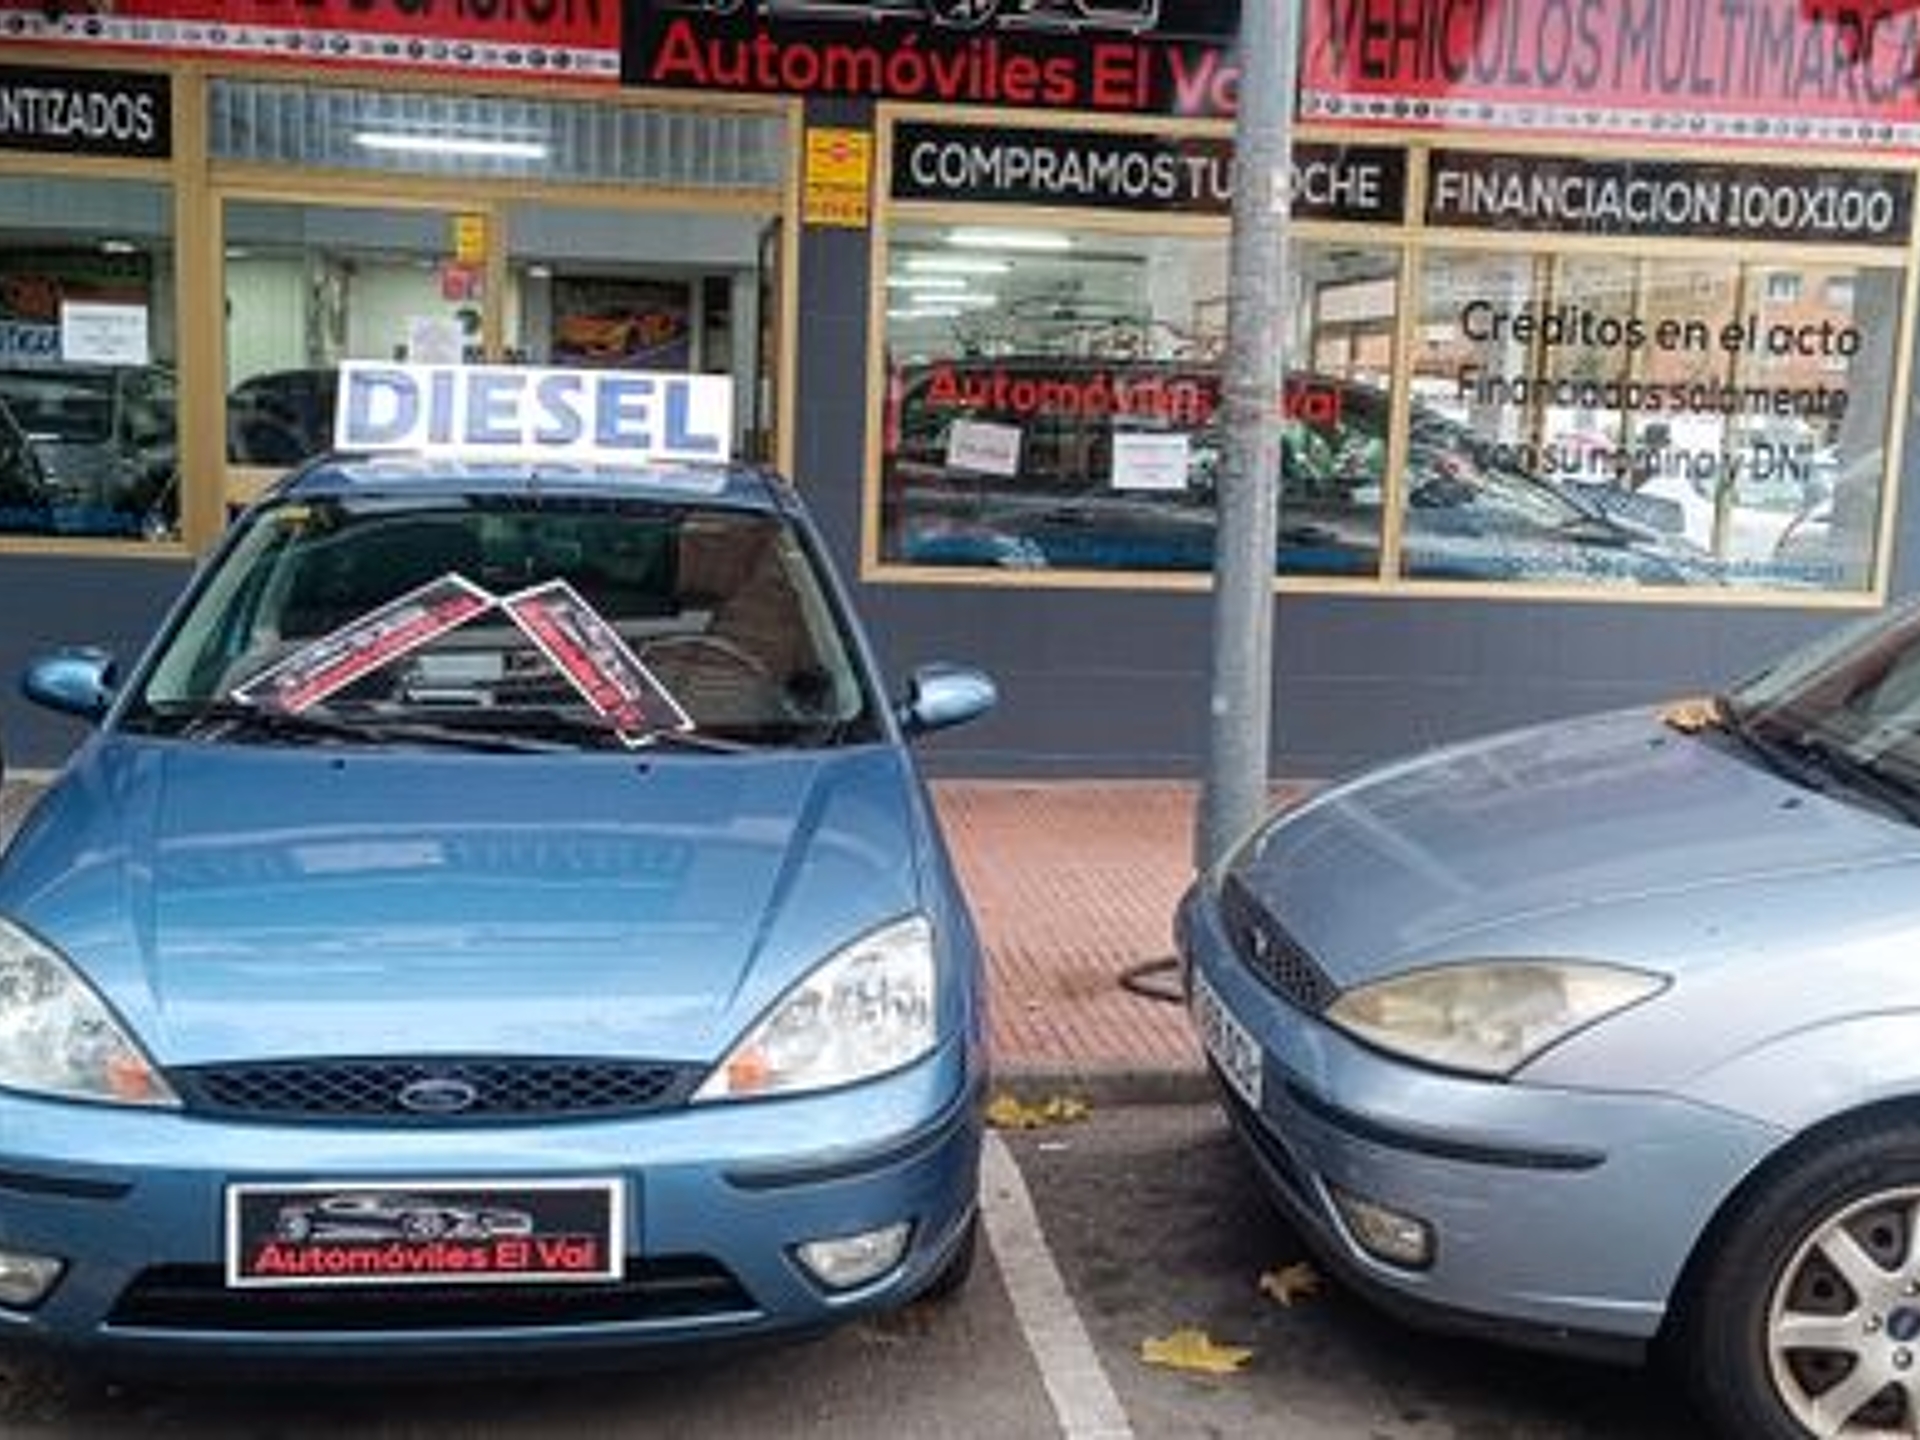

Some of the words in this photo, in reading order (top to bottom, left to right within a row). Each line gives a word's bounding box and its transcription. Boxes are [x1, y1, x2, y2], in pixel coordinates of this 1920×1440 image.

[653, 19, 1077, 103] Automóviles
[1092, 43, 1149, 108] El
[909, 141, 1177, 199] COMPRAMOS
[1435, 170, 1719, 226] FINANCIACION
[1727, 184, 1893, 232] 100X100
[1462, 300, 1646, 349] Créditos
[1656, 317, 1707, 352] en
[1719, 314, 1756, 354] el
[1767, 318, 1862, 357] acto
[345, 369, 720, 454] DIESEL
[257, 1242, 487, 1273] Automóviles
[497, 1241, 528, 1269] El
[537, 1240, 595, 1270] Val
